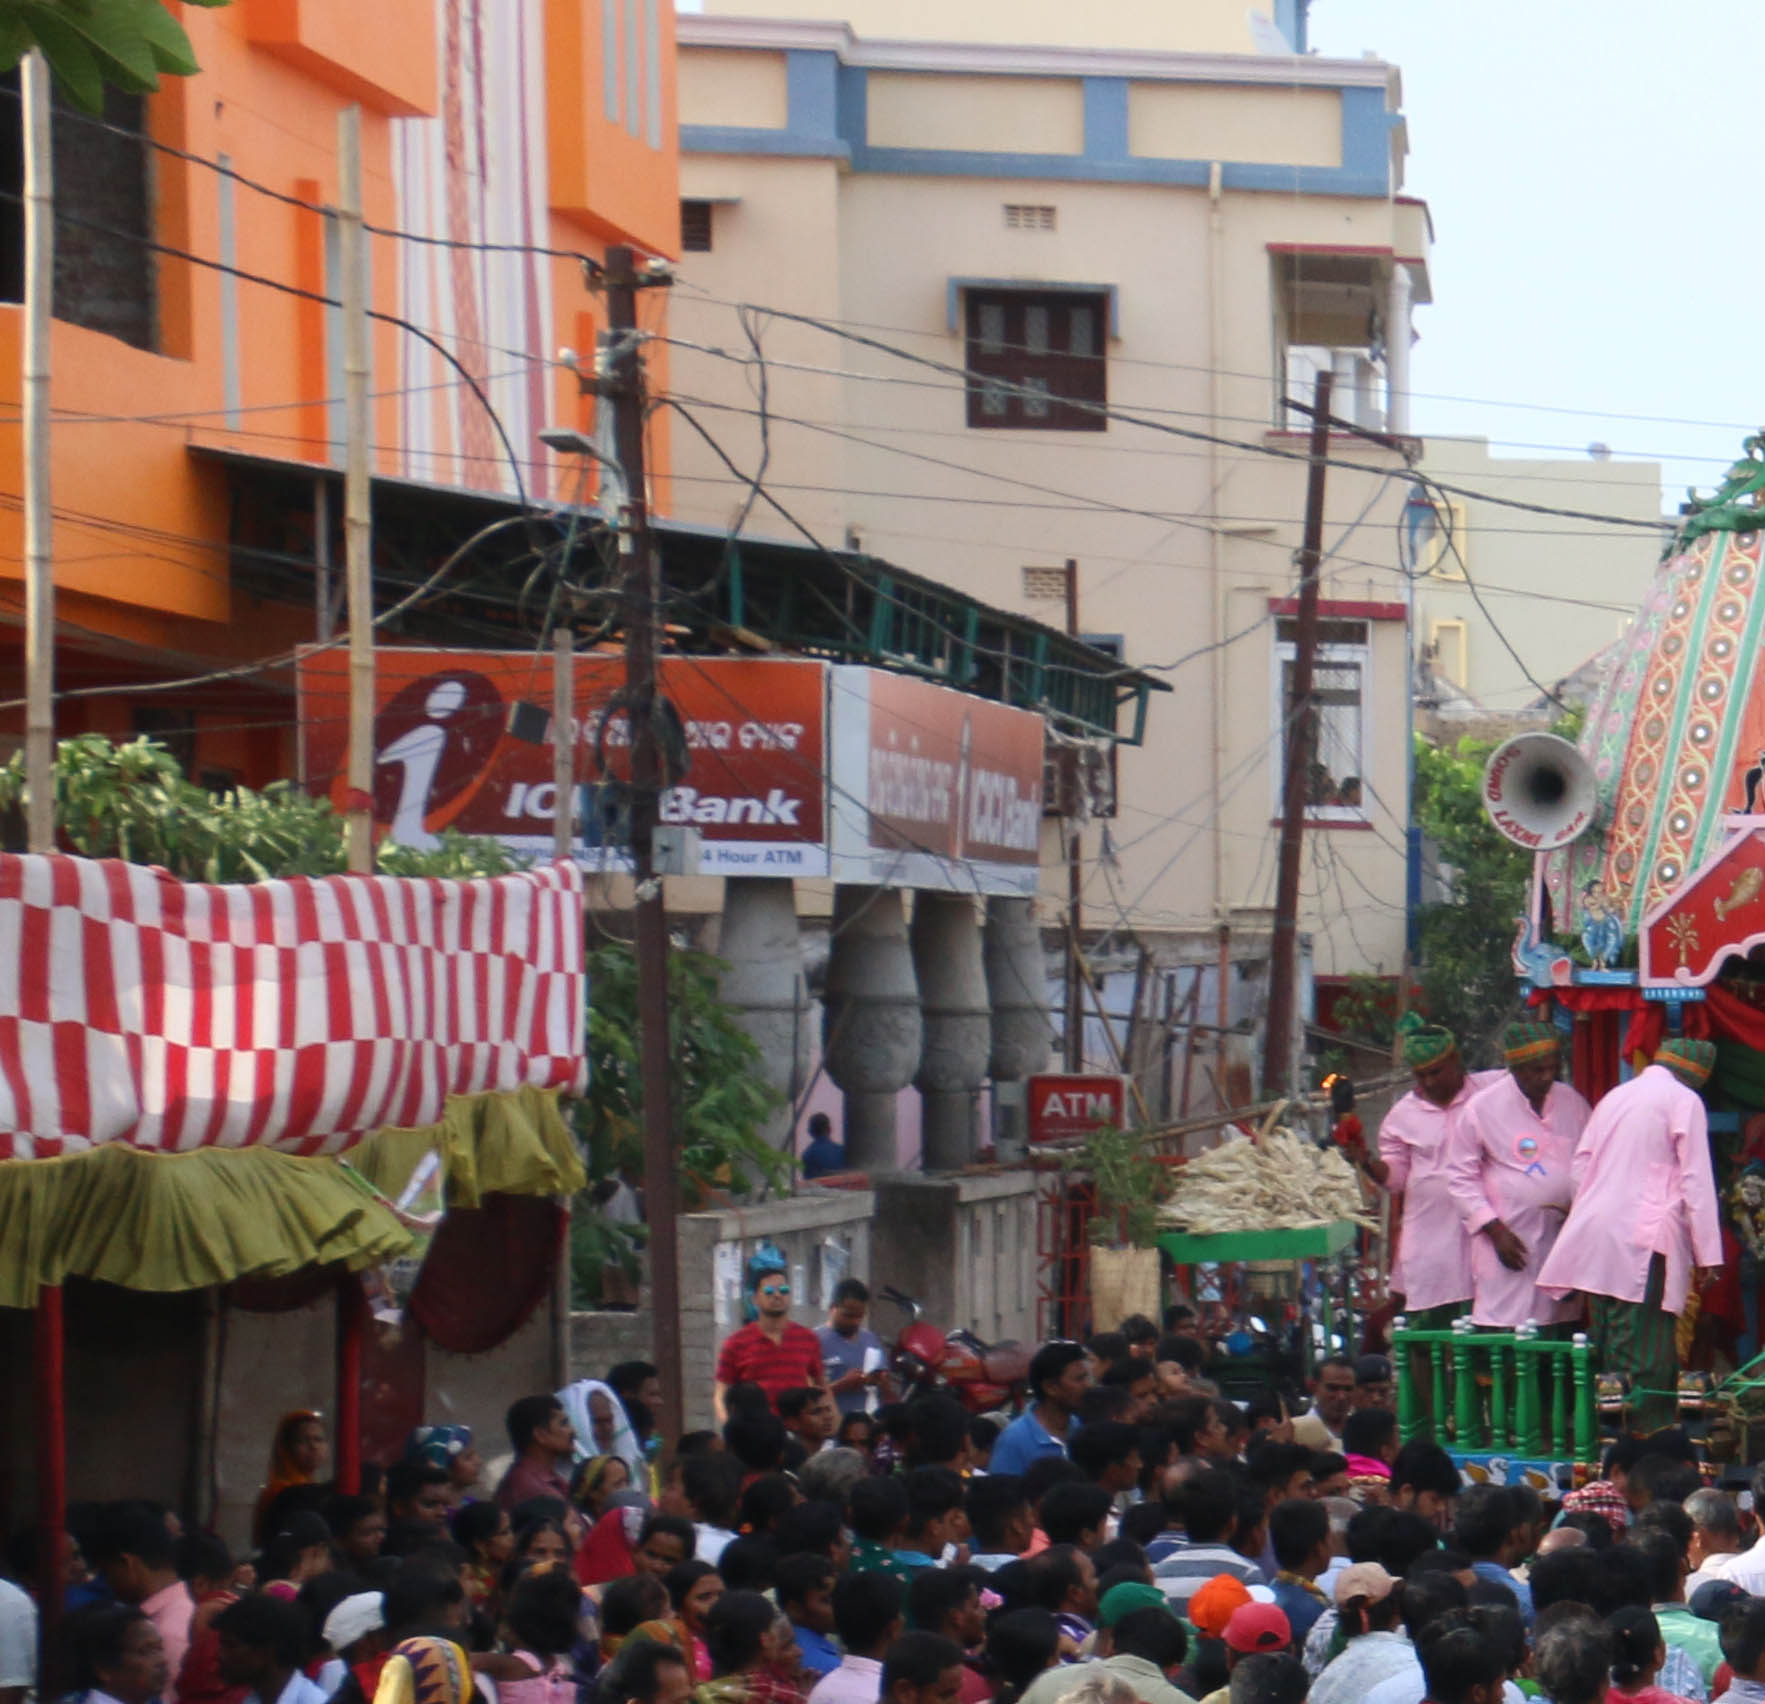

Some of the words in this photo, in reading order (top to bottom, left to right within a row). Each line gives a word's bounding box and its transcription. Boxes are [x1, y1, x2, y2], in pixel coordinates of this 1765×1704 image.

[658, 786, 801, 825] Bank
[717, 850, 757, 865] Hour
[763, 850, 803, 865] ATM
[1041, 1092, 1112, 1118] ATM
